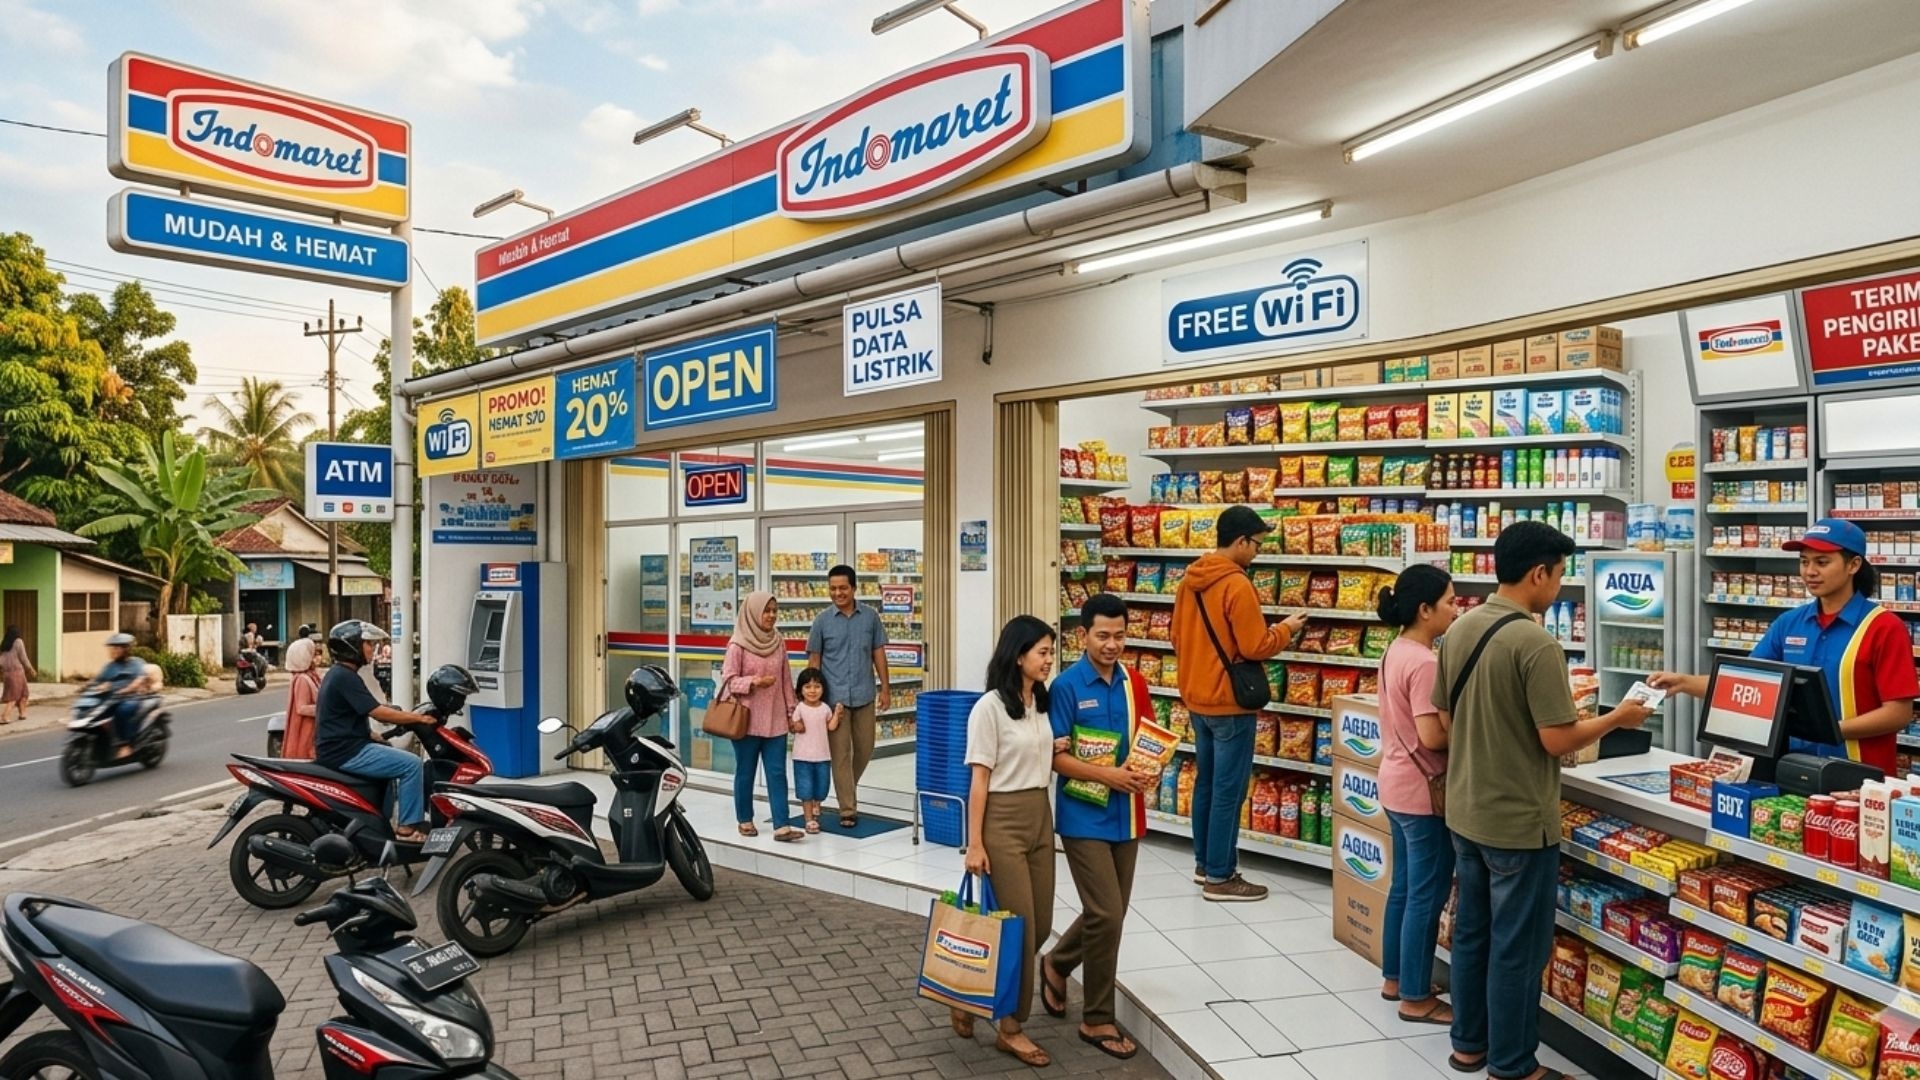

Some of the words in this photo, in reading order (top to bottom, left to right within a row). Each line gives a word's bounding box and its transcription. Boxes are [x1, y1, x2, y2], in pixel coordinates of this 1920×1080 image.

[186, 109, 363, 175] Indomaret
[795, 73, 1012, 195] Indomaret
[164, 212, 263, 249] MUDAH
[270, 232, 288, 252] &
[296, 235, 377, 266] HEMAT
[852, 299, 922, 333] PULSA
[1178, 304, 1249, 340] FREE
[1823, 306, 1920, 338] PENGIRI
[852, 330, 908, 358] DATA
[653, 345, 763, 411] OPEN
[853, 350, 933, 384] LISTRIK
[488, 385, 546, 414] PROMO!
[566, 388, 628, 441] 20%
[324, 459, 383, 483] ATM
[687, 470, 741, 499] OPEN
[1605, 572, 1656, 595] AQUA
